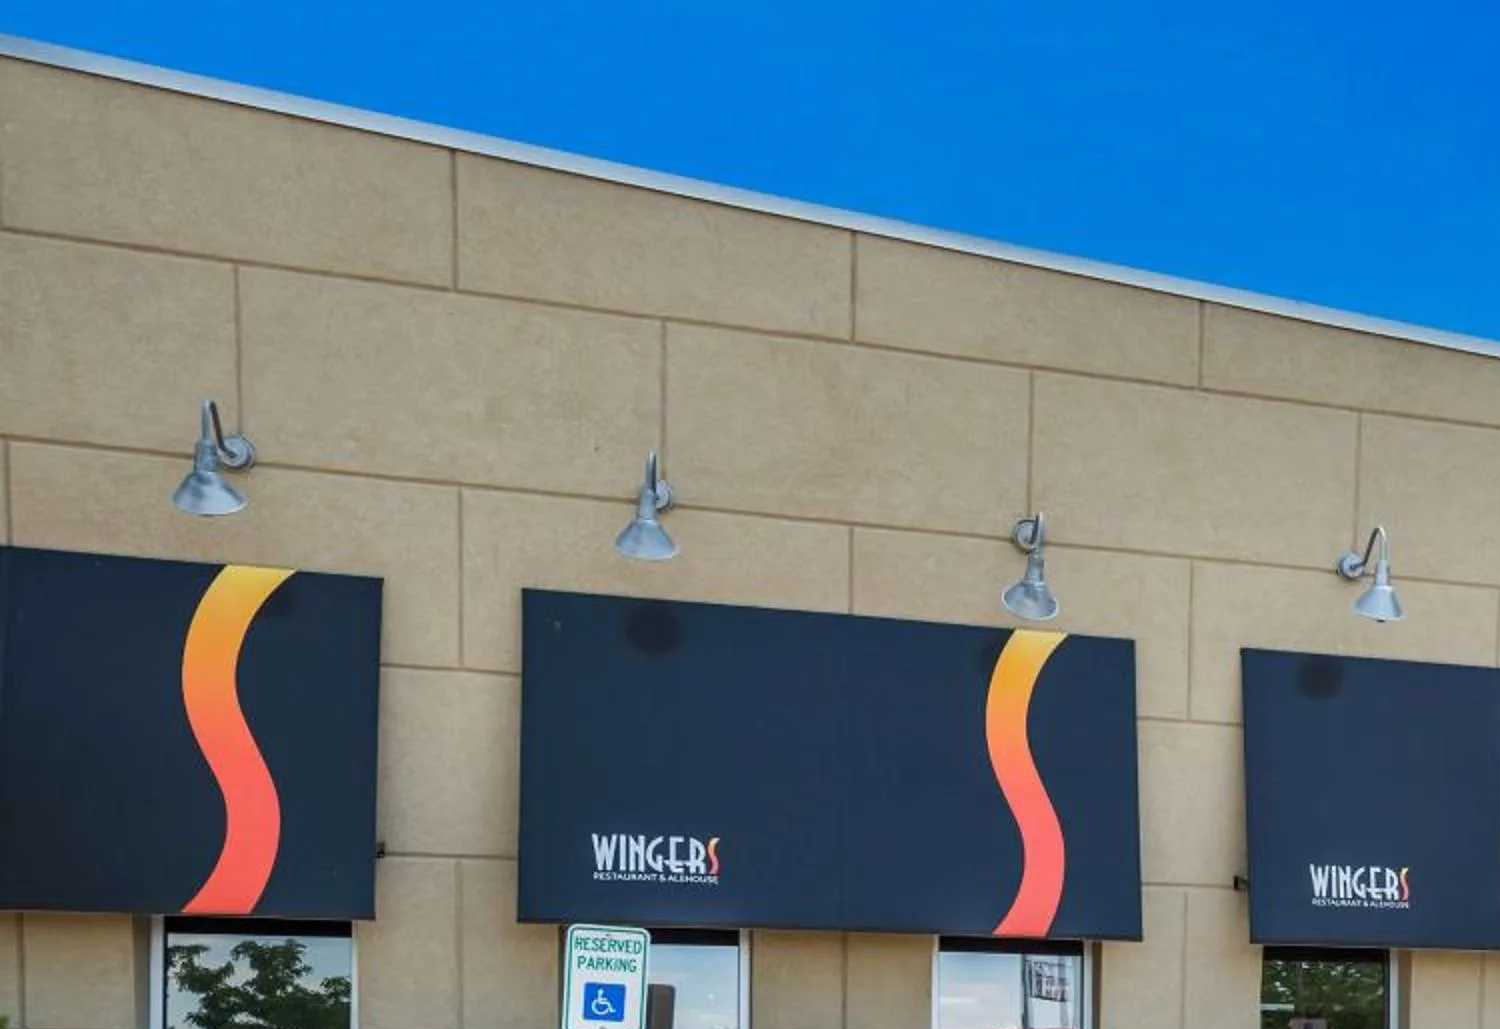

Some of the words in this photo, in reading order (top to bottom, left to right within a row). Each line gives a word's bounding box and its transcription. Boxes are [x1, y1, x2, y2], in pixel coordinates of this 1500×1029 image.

[591, 832, 721, 875] WINGERS
[1309, 863, 1409, 901] WINGERS
[574, 936, 642, 955] RESERVED
[577, 955, 637, 973] PARKING
